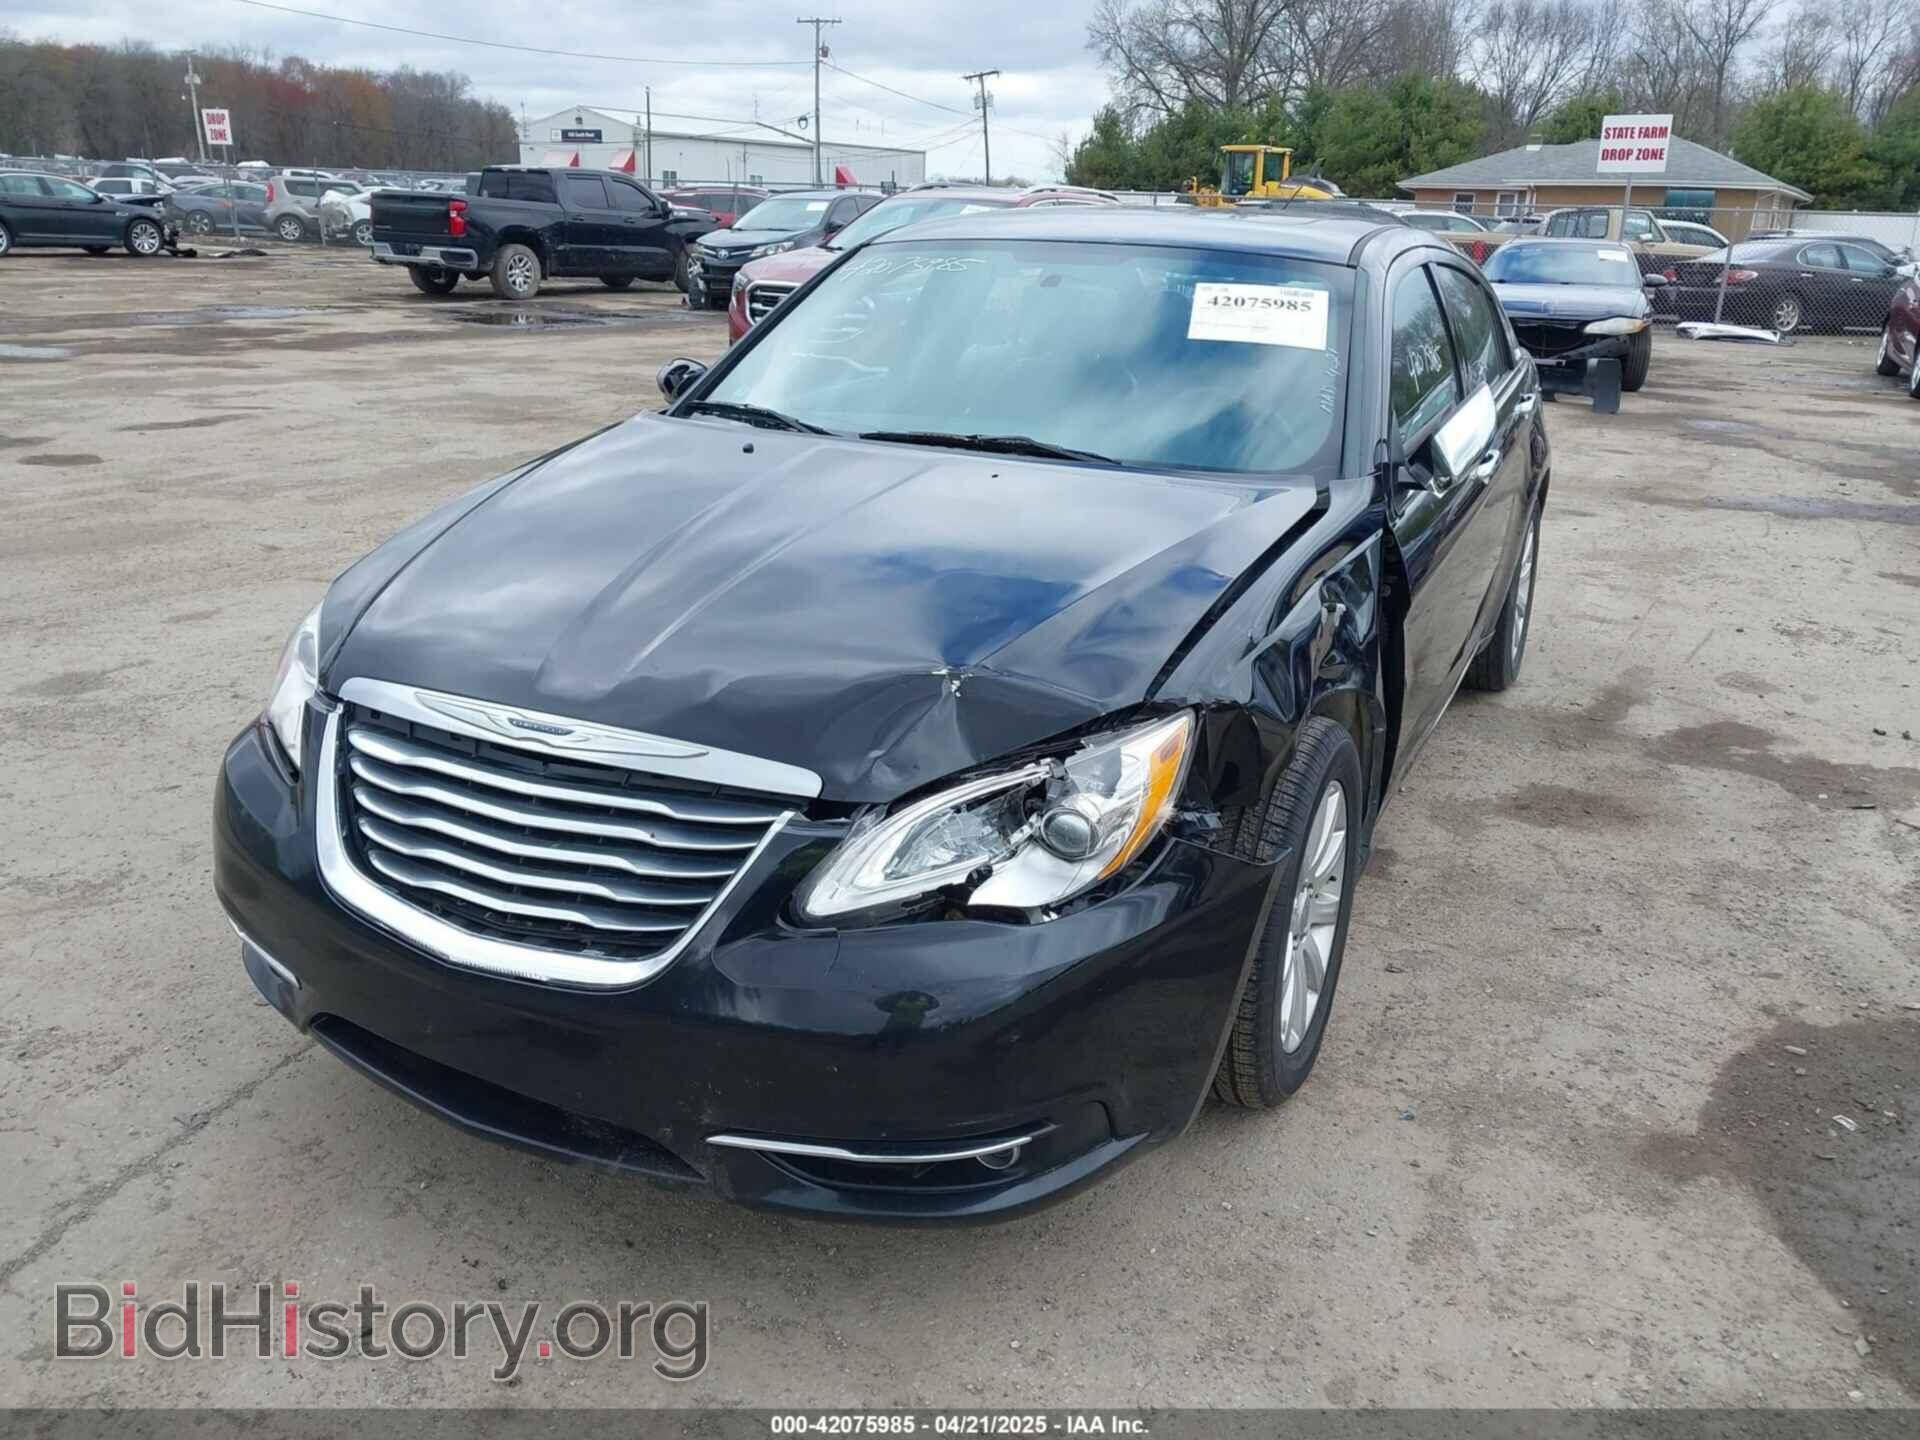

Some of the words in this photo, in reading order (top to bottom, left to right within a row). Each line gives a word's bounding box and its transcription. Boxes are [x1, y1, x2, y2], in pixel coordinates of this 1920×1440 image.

[206, 112, 225, 125] DROP
[1604, 126, 1635, 140] STATE
[1637, 126, 1669, 139] FARM
[1601, 148, 1633, 161] DROP
[1635, 147, 1665, 161] ZONE
[1207, 295, 1313, 313] 42075985
